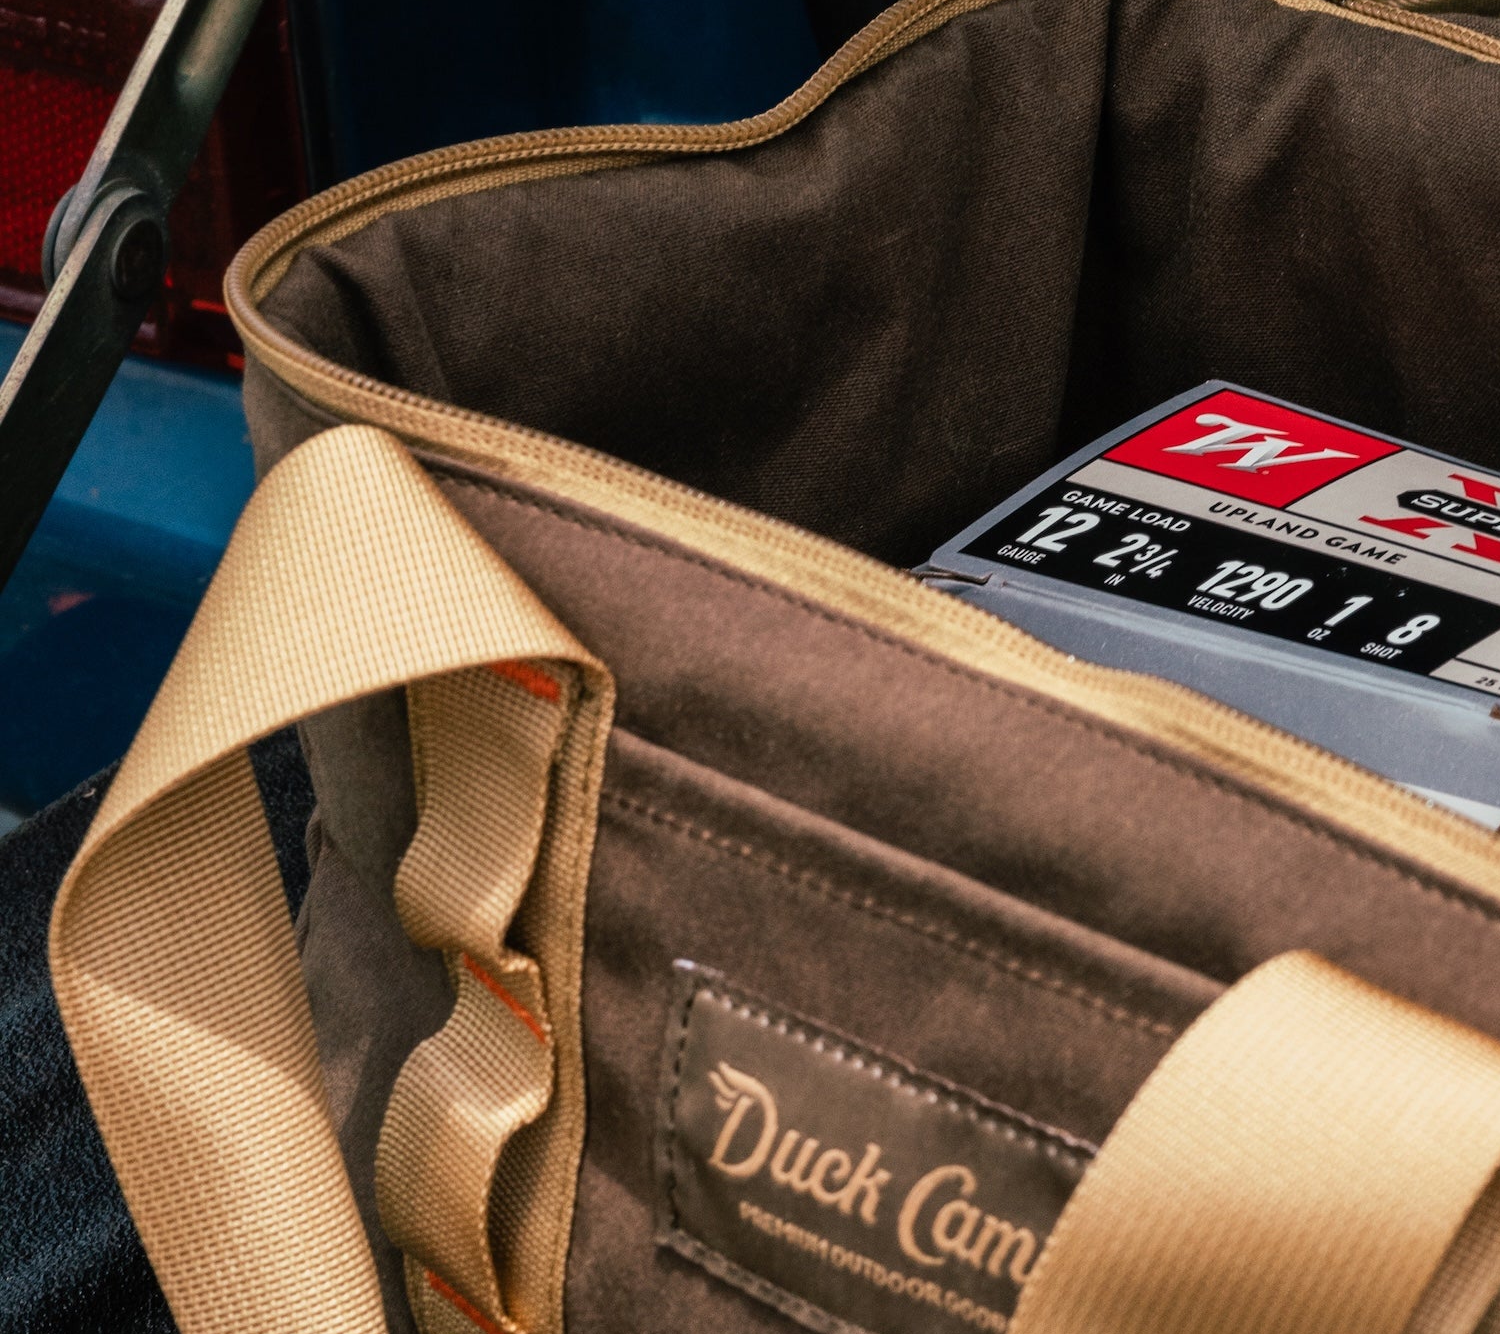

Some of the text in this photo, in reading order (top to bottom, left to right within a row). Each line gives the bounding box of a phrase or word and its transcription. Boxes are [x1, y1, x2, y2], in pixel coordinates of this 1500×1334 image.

[1062, 490, 1192, 532] GAME LOAD
[1208, 501, 1408, 565] UPLAND GAME
[997, 545, 1402, 660] GAUGE IN VELOCITY OZ SHOT
[1015, 506, 1100, 553] 12
[1196, 560, 1314, 611] 1290
[1323, 595, 1374, 627] 1
[1386, 614, 1441, 645] 8
[1474, 676, 1496, 689] 25
[707, 1061, 1042, 1285] Duck Cam
[829, 1244, 942, 1307] OUTDOOR
